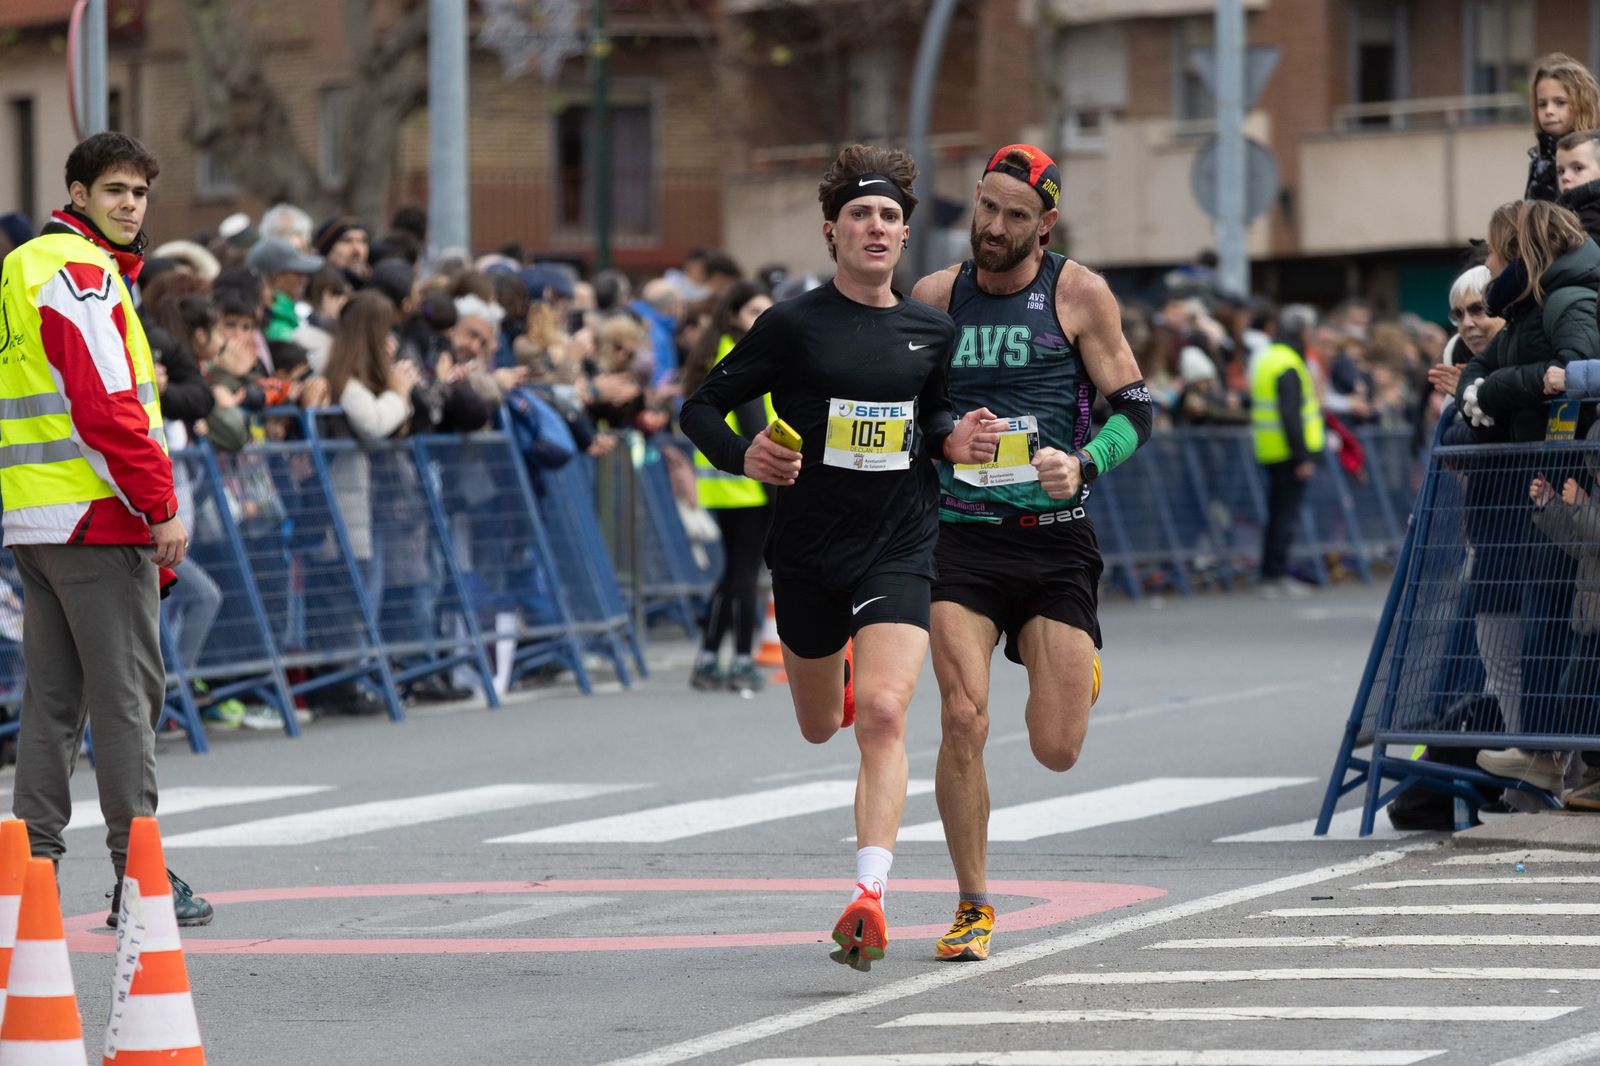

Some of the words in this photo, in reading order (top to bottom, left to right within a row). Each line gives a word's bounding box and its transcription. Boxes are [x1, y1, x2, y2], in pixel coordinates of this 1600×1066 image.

[1029, 292, 1045, 302] AVS
[1027, 301, 1044, 310] 1990
[951, 325, 1031, 368] AVS
[855, 405, 906, 417] SETEL
[851, 420, 886, 447] 105
